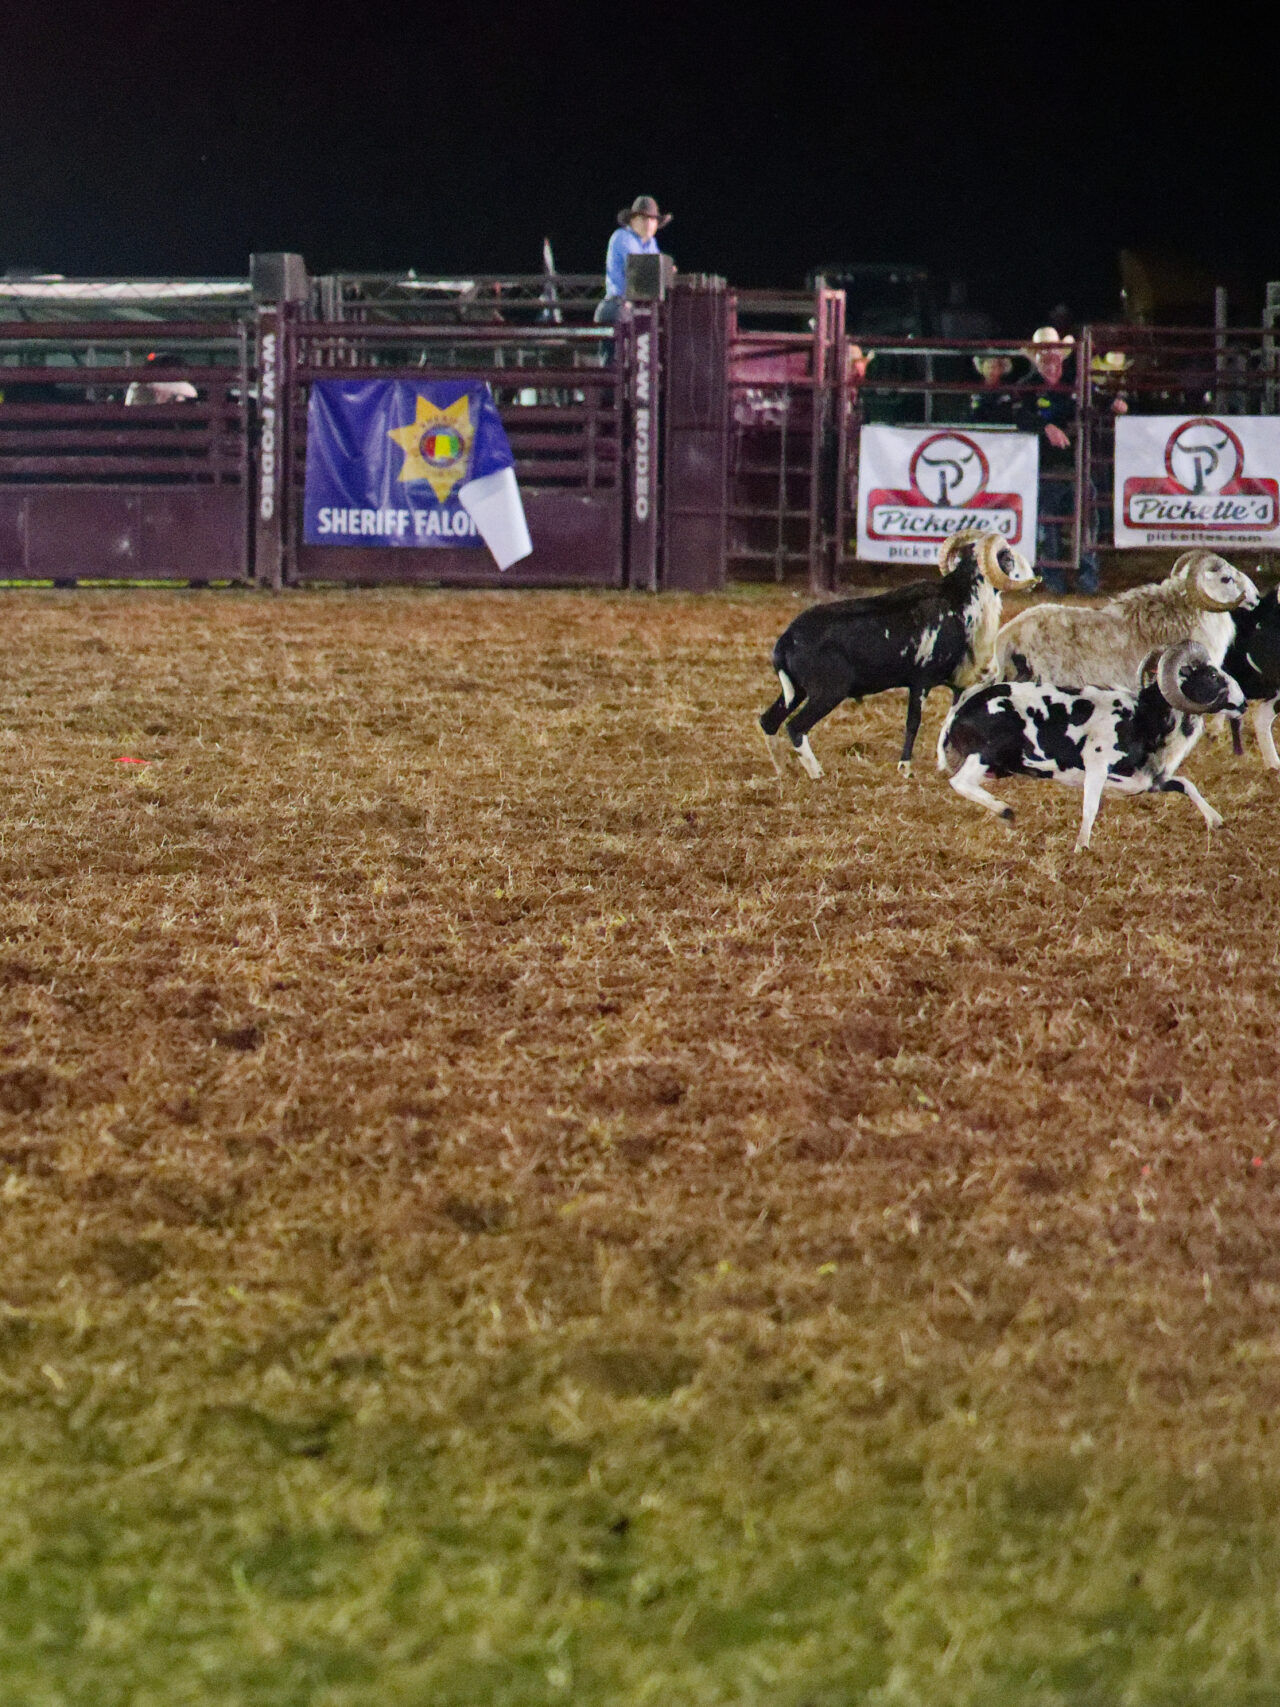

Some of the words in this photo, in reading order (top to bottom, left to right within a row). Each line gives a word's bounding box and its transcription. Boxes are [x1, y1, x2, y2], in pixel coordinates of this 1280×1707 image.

[260, 406, 276, 522] RODEO
[635, 408, 650, 521] RODEO
[317, 507, 410, 537] SHERIFF
[877, 509, 1012, 534] Pickette's
[1133, 498, 1269, 521] Pickette's
[1146, 532, 1262, 543] pickettes.com
[888, 545, 940, 559] picket
